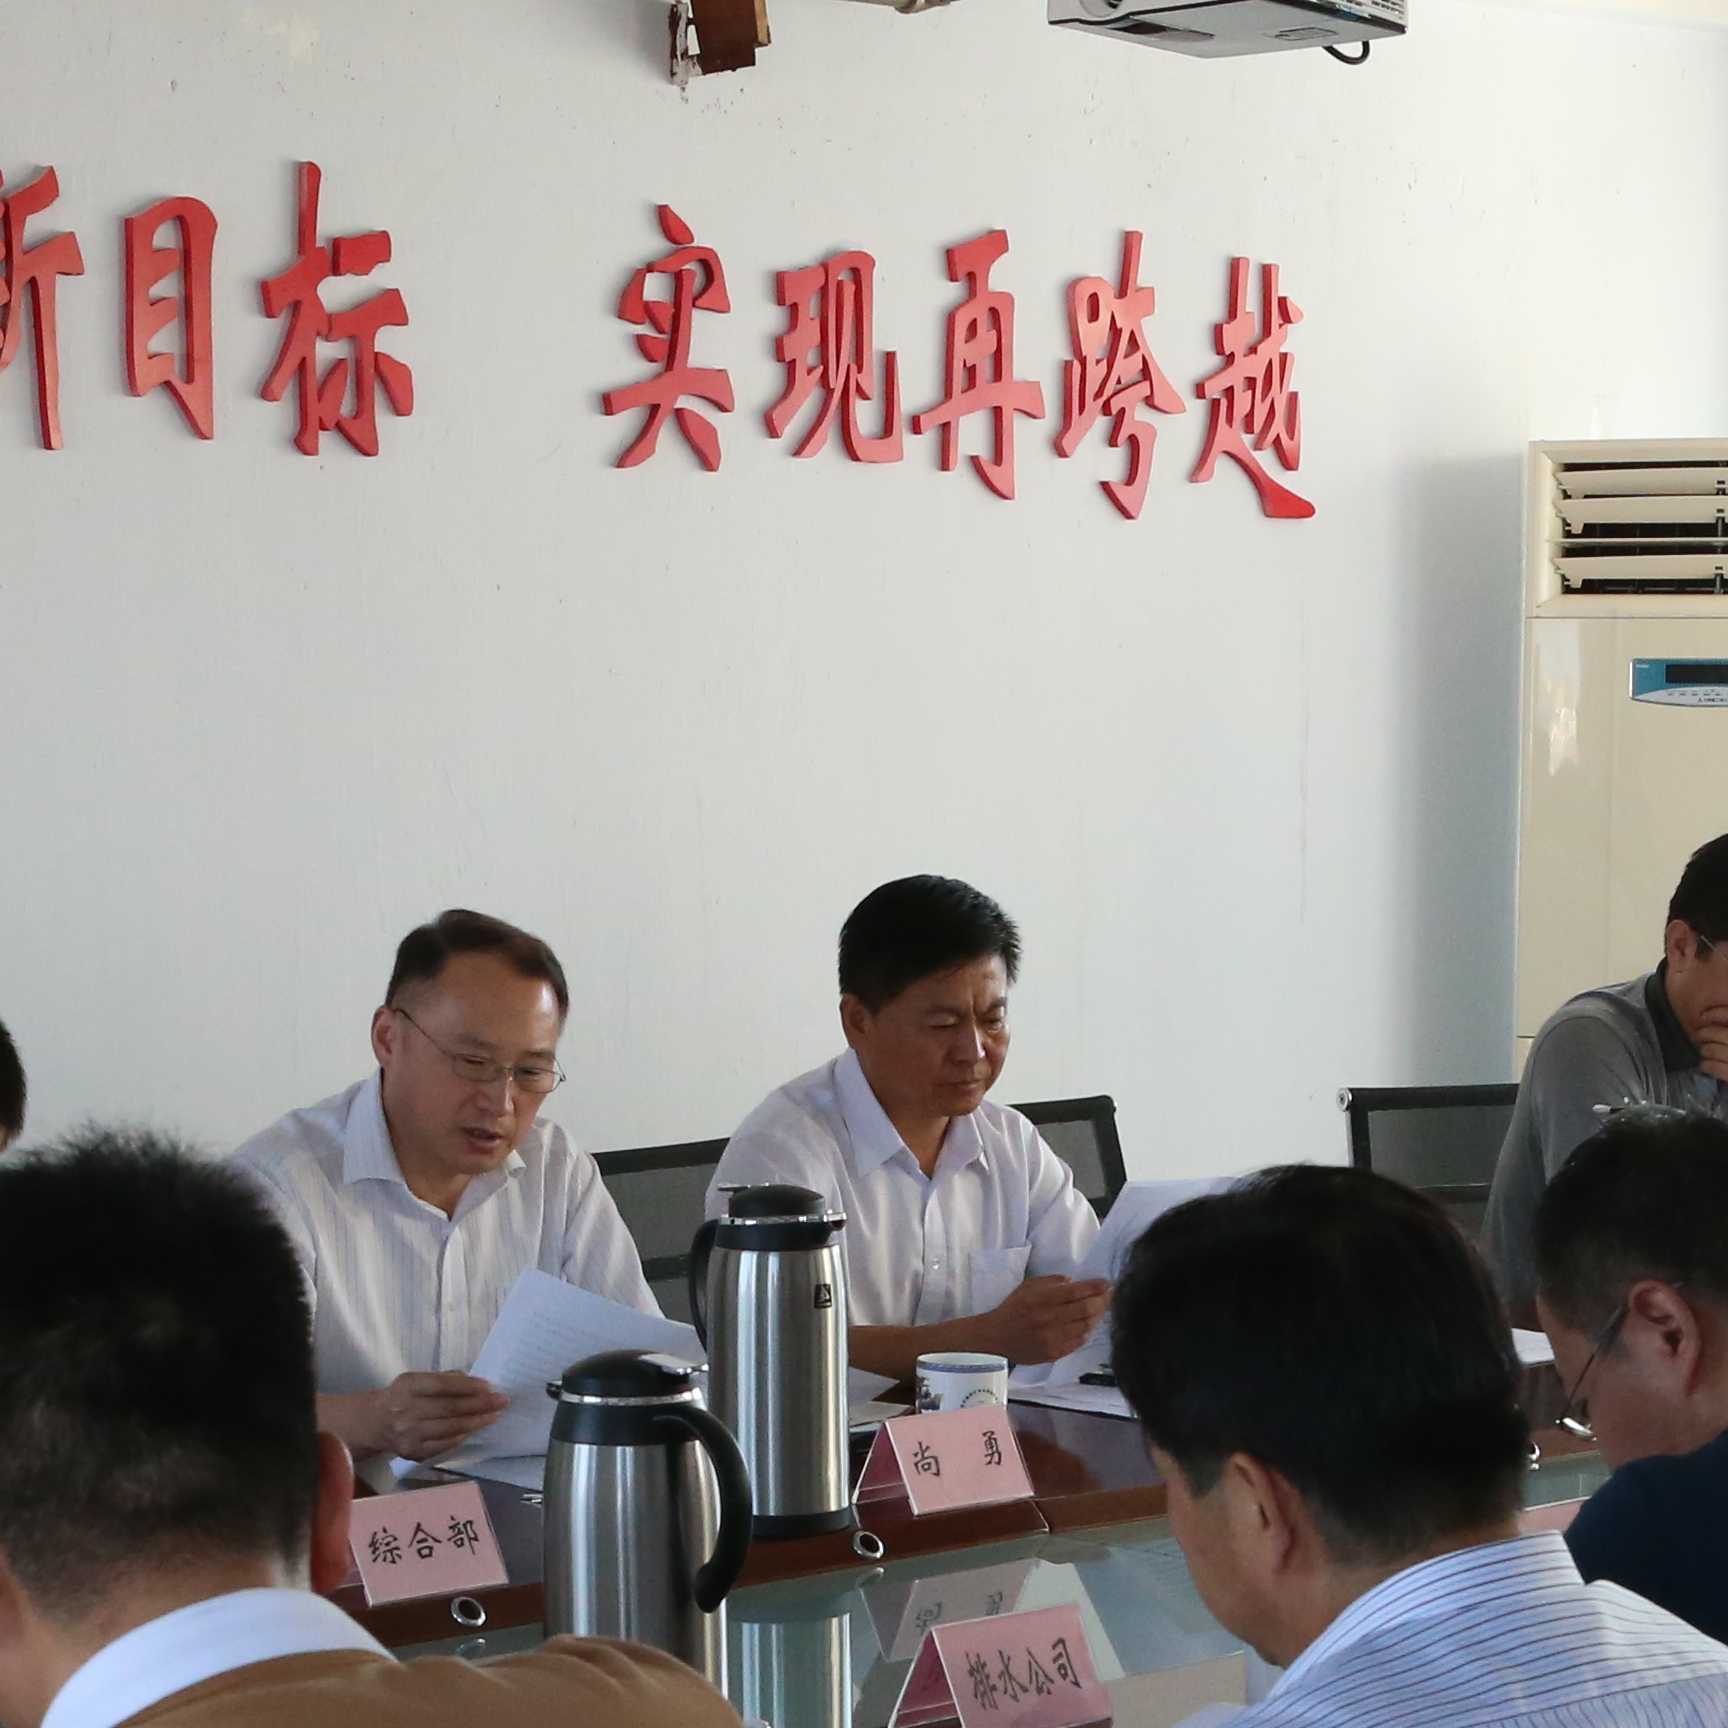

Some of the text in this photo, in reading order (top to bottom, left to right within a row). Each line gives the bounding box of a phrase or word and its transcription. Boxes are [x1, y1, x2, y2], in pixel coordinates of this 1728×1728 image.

[603, 204, 1316, 519] 实现再跨越
[368, 1515, 480, 1565] 综合部
[966, 1638, 1083, 1710] 排水公司
